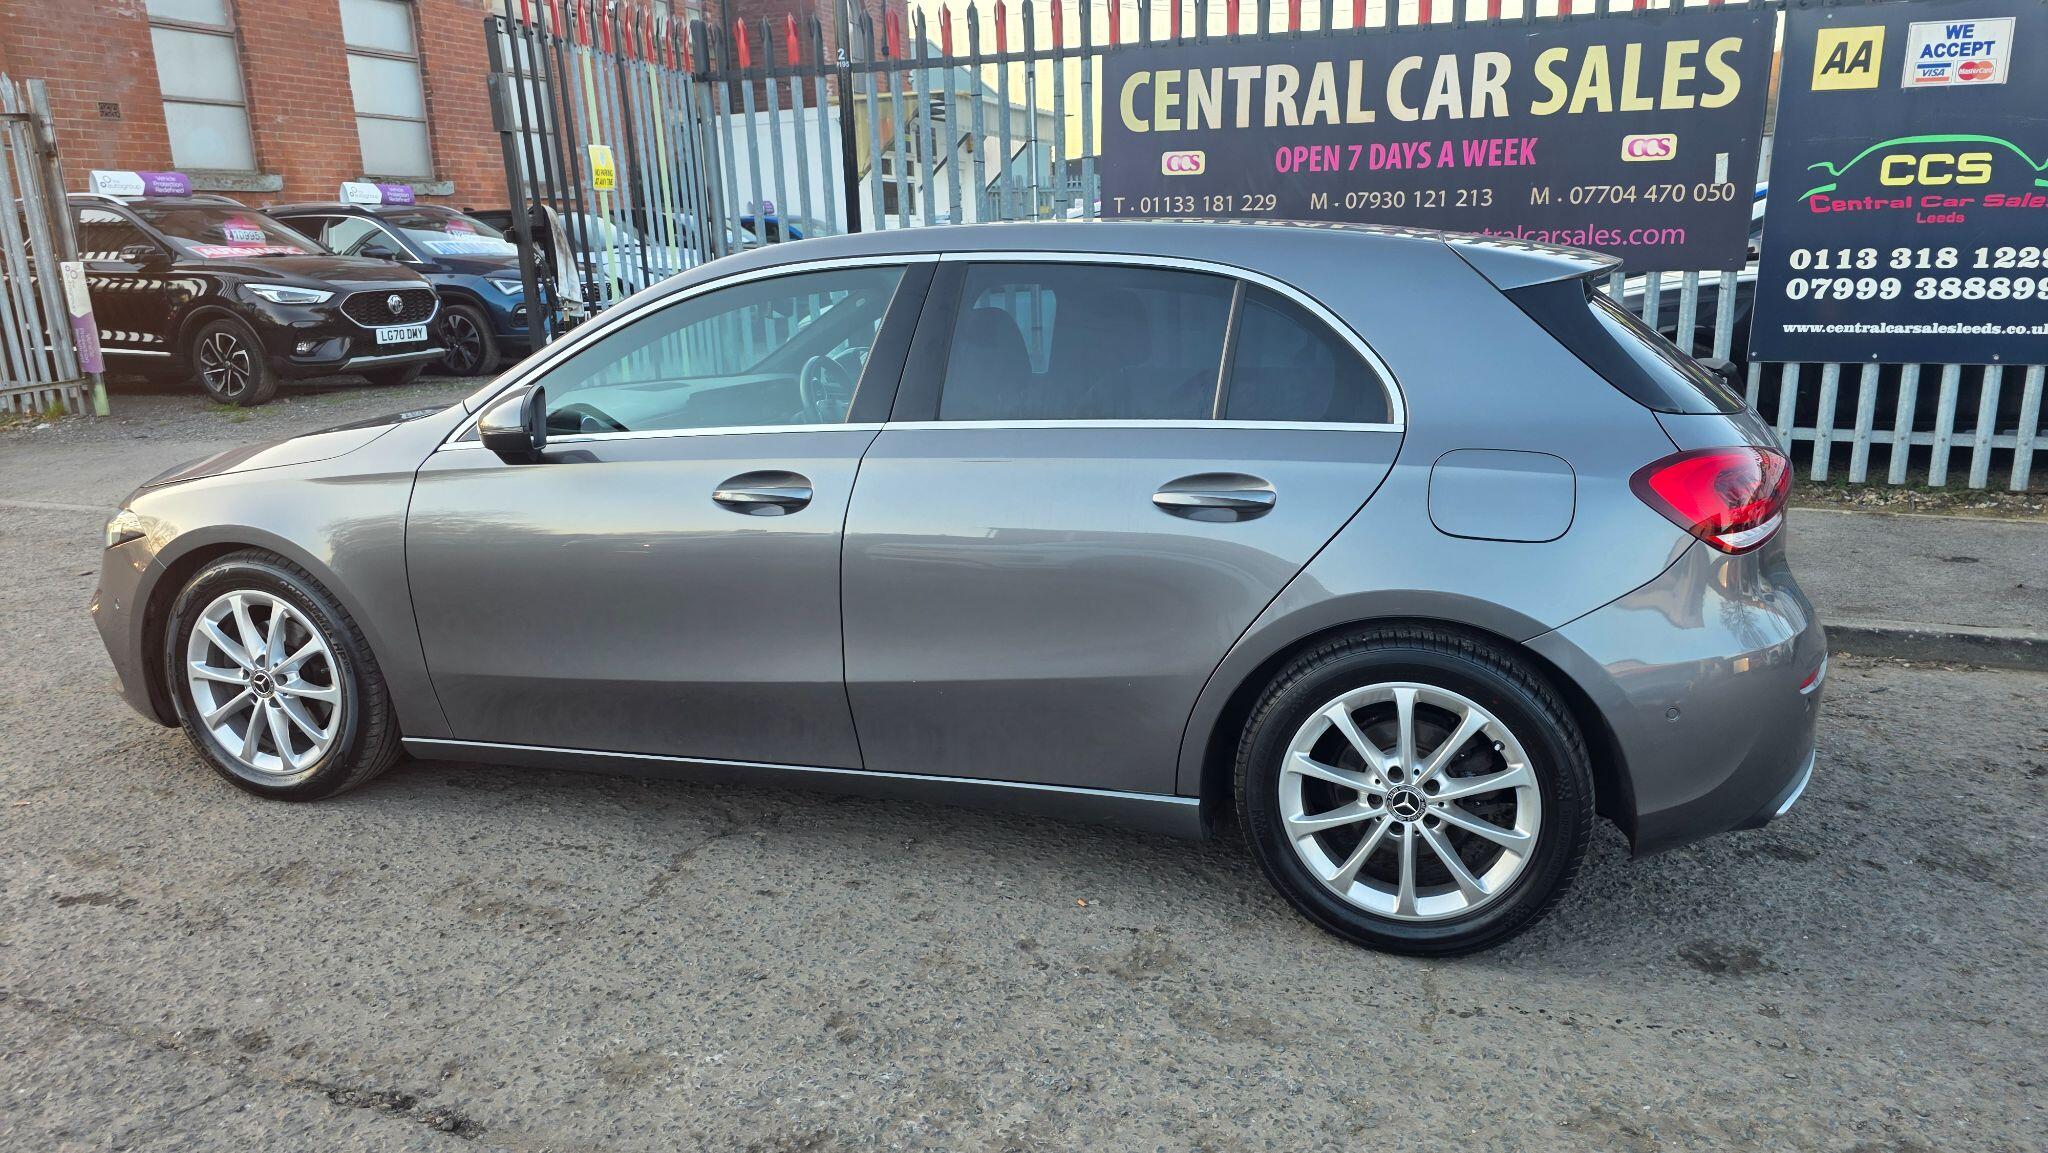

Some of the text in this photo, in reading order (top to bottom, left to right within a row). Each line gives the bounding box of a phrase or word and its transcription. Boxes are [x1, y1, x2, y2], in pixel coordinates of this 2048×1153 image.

[1946, 24, 1975, 40] WE
[837, 48, 845, 60] 2
[1820, 40, 1873, 75] AA
[1919, 41, 1996, 59] ACCEPT
[1922, 68, 1945, 77] VISA
[1958, 66, 1994, 76] MasterCard
[1119, 37, 1743, 133] CENTRAL CAR SALES
[1275, 137, 1539, 173] OPEN 7 DAYS A WEEK
[1879, 152, 1993, 186] CCS
[1113, 197, 1126, 213] T
[1140, 195, 1195, 213] 01133
[1203, 195, 1233, 212] 181
[1240, 194, 1277, 211] 229
[1310, 192, 1328, 210] M
[1345, 190, 1406, 209] 07930
[1414, 190, 1446, 208] 121
[1456, 188, 1493, 208] 213
[1530, 187, 1550, 205] M
[1569, 184, 1637, 205] 07704
[1643, 183, 1686, 203] 470
[1693, 182, 1736, 202] 050
[1809, 193, 2048, 213] Central Car Sale
[1916, 212, 1965, 224] Leeds
[1789, 247, 1878, 270] 0113
[1890, 247, 1958, 269] 318
[1785, 277, 1902, 300] 07999
[380, 328, 423, 341] LG70 DMY
[1783, 322, 2048, 335] www.centralcarsalesleeds.co.u
